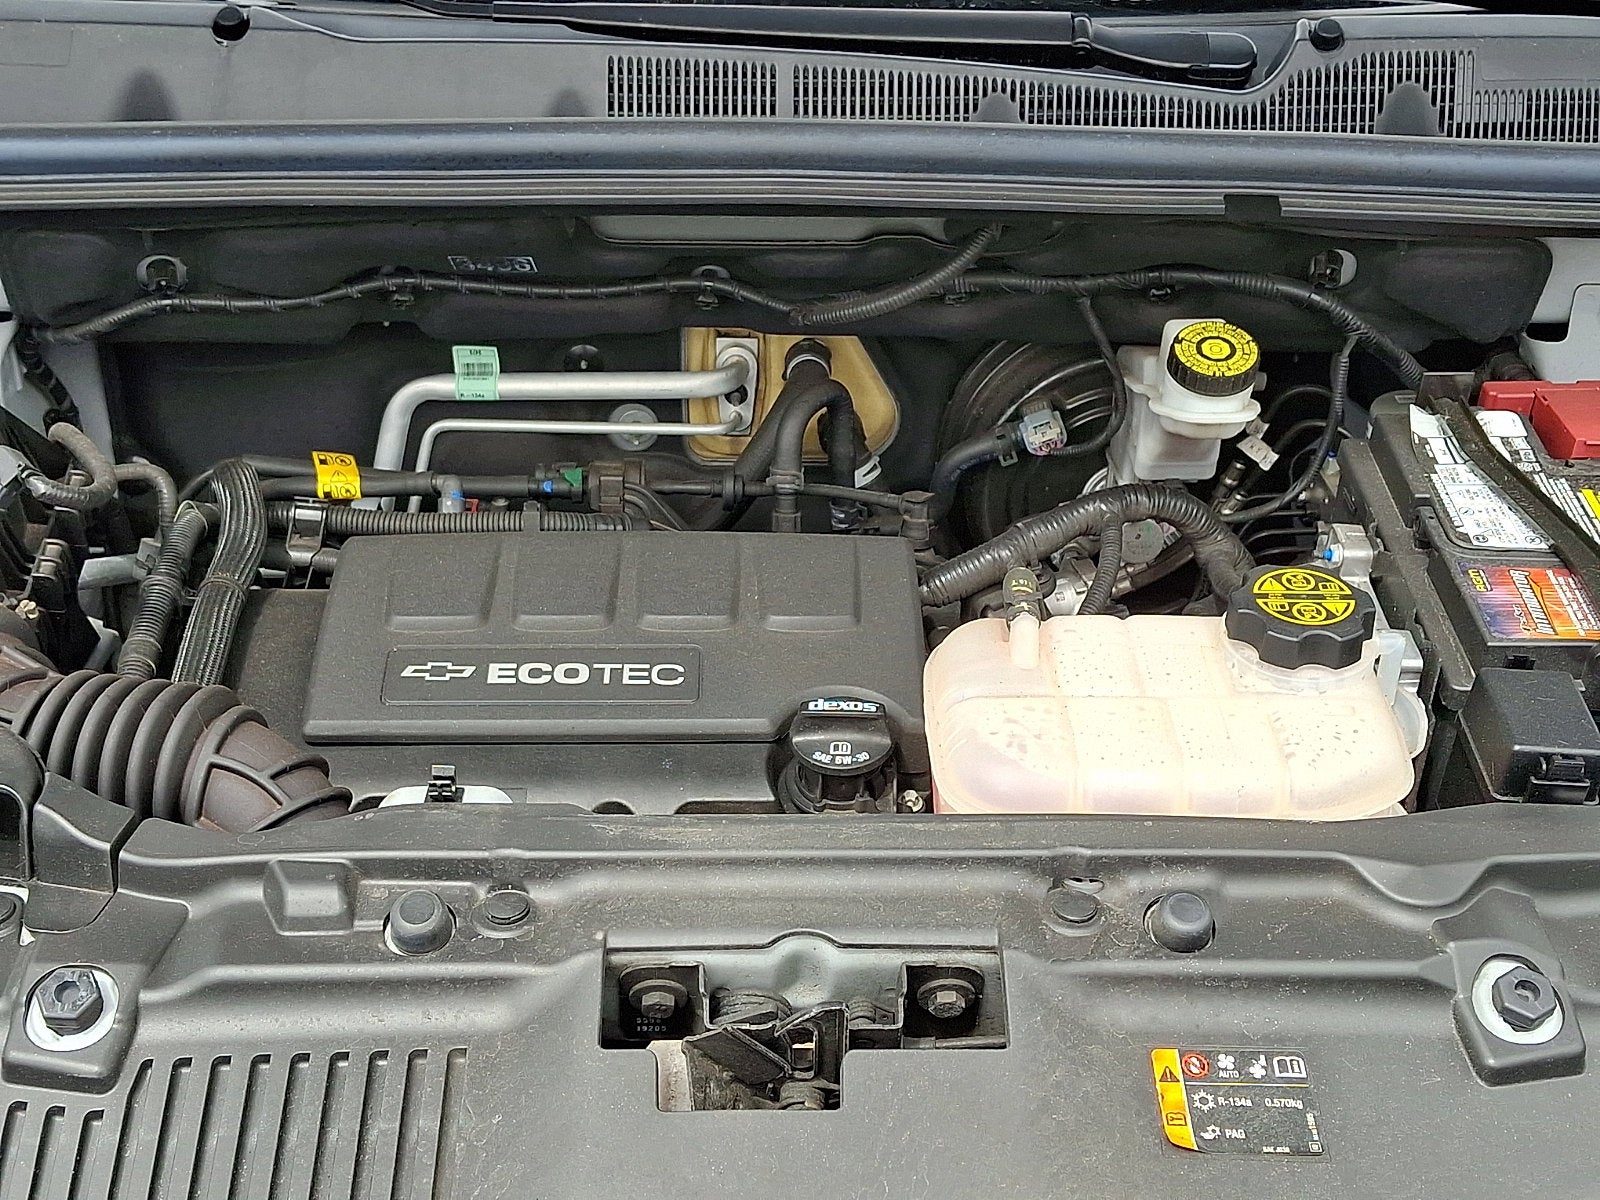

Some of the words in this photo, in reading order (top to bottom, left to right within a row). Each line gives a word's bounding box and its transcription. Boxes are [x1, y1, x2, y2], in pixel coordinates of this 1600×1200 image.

[1467, 569, 1488, 593] AGM
[486, 662, 686, 686] ECOTEC
[807, 698, 880, 713] dexos
[812, 751, 833, 764] SAE
[1218, 1069, 1240, 1079] AUTO
[1217, 1096, 1253, 1107] R-134a
[1264, 1097, 1304, 1110] 0.570kg
[1225, 1129, 1246, 1139] PAG
